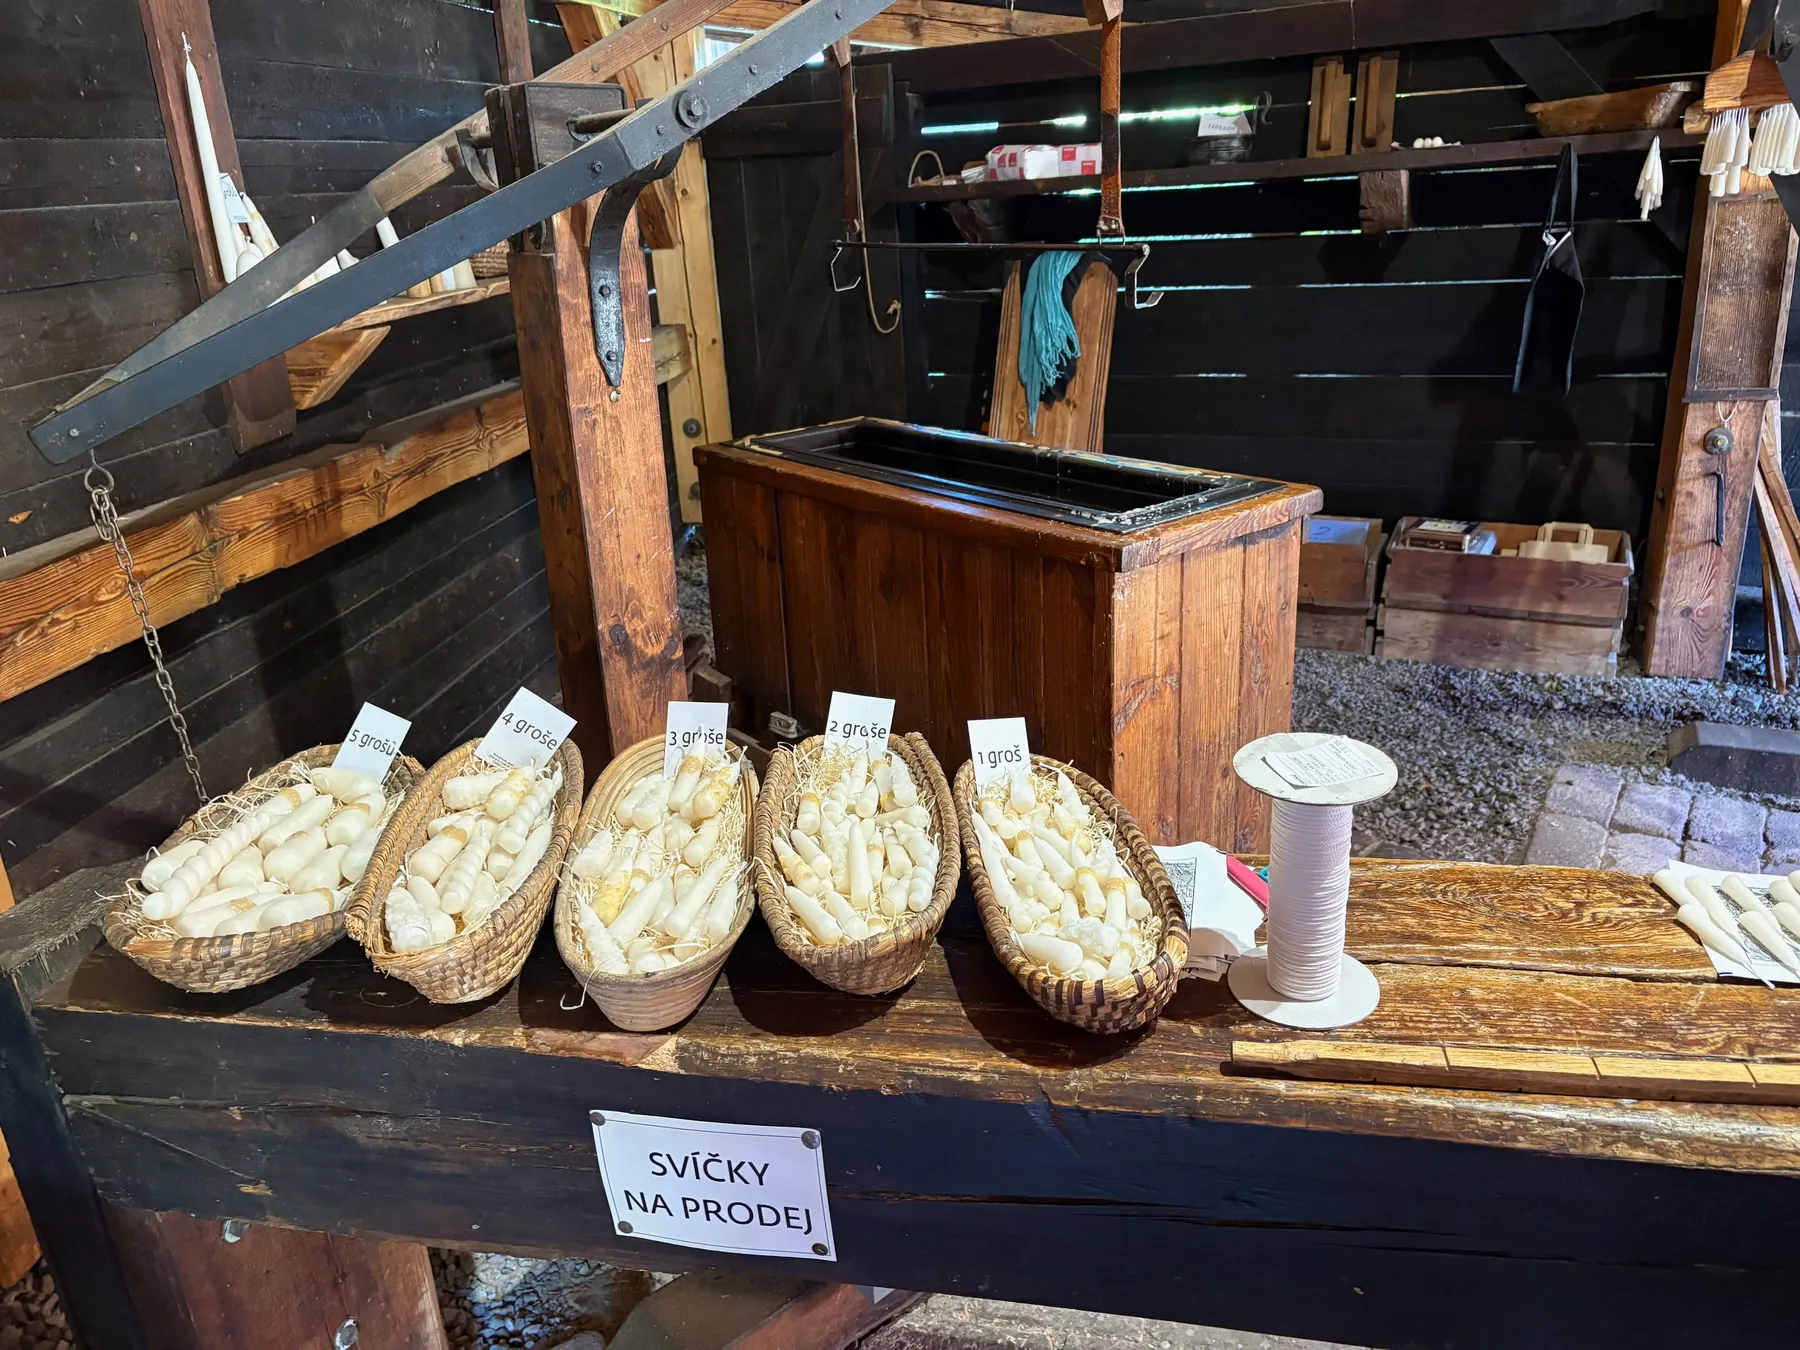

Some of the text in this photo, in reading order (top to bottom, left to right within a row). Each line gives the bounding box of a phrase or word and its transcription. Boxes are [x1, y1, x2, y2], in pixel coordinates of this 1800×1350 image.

[349, 729, 397, 756] 5 grošů
[502, 712, 557, 750] 4 groše
[669, 731, 677, 746] 3
[829, 720, 887, 739] 2 groše
[977, 744, 1022, 769] 1 groš
[649, 1151, 769, 1186] SVÍČKY
[623, 1189, 813, 1235] NA PRODEJ
